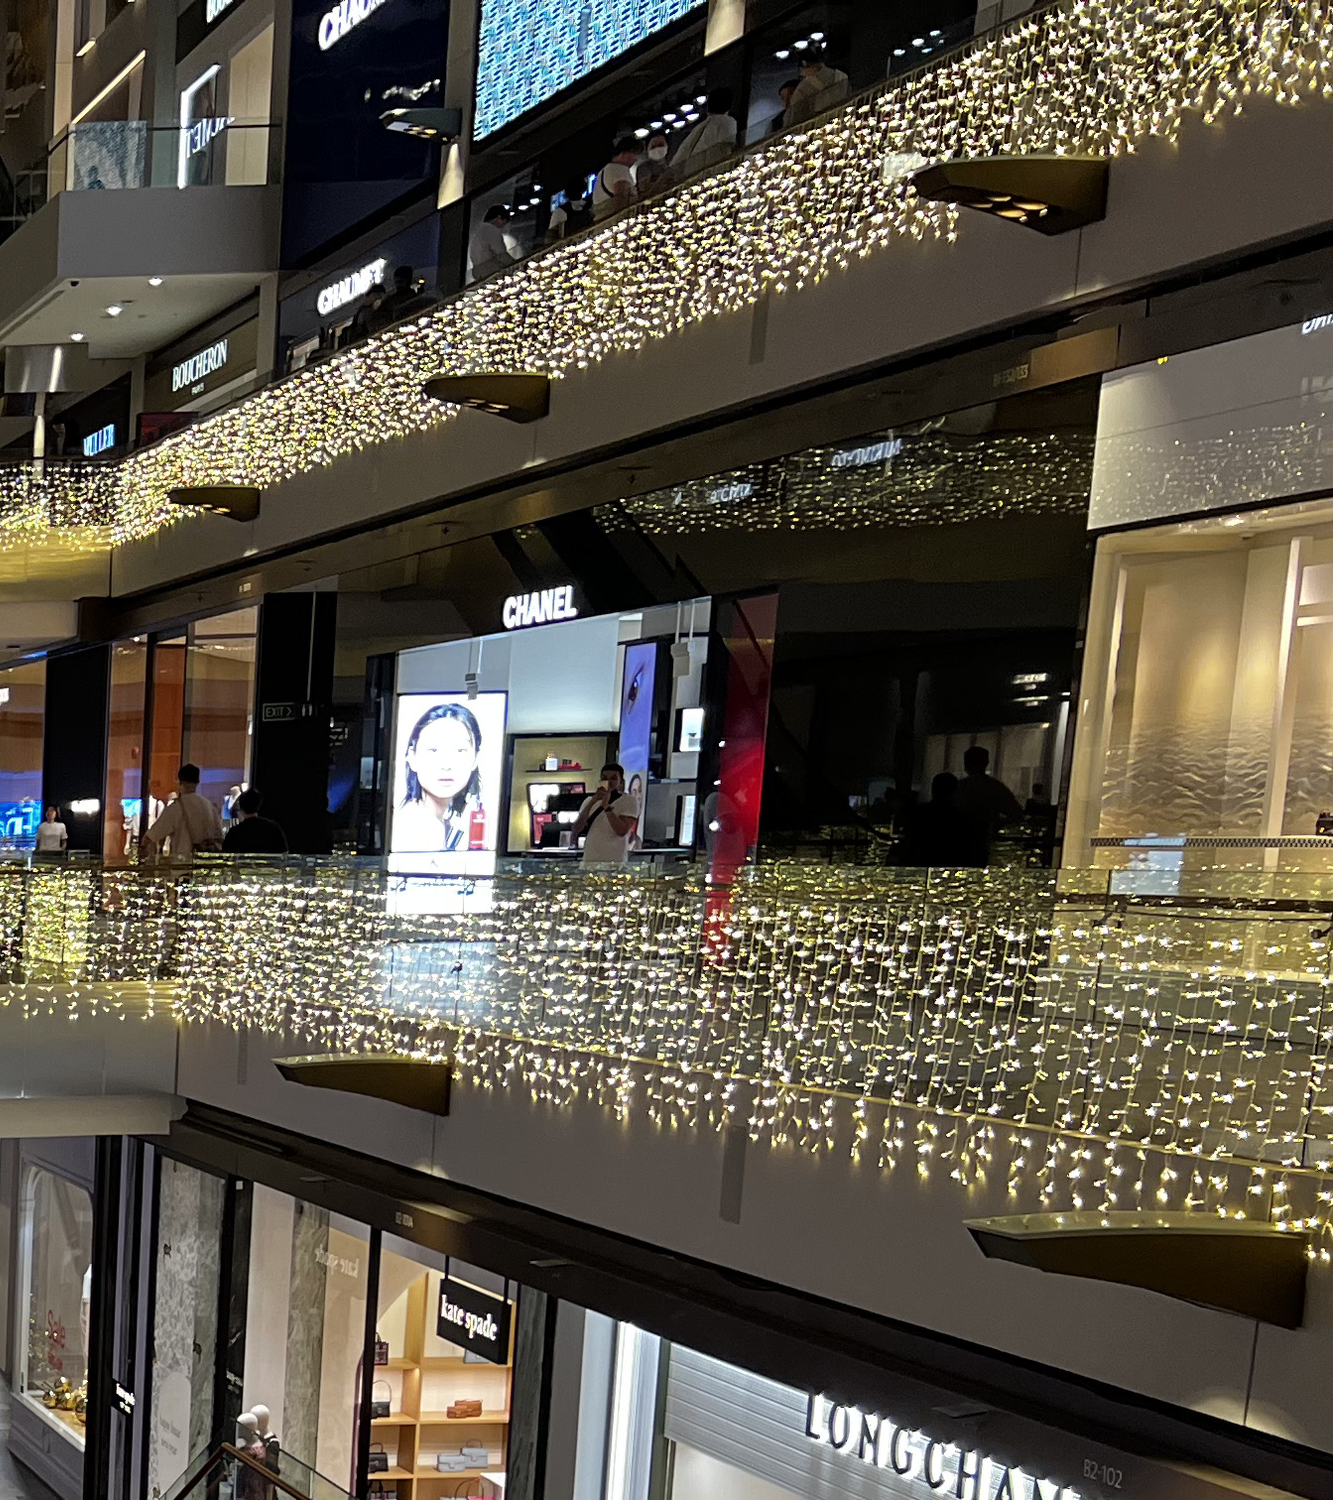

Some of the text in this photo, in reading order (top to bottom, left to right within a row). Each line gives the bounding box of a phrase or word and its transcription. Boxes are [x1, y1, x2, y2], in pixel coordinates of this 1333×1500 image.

[172, 338, 228, 392] BOUCHERON
[502, 584, 578, 629] CHANEL
[265, 706, 284, 718] EXIT
[439, 1293, 498, 1341] kate spade
[1083, 1458, 1123, 1489] B2-102
